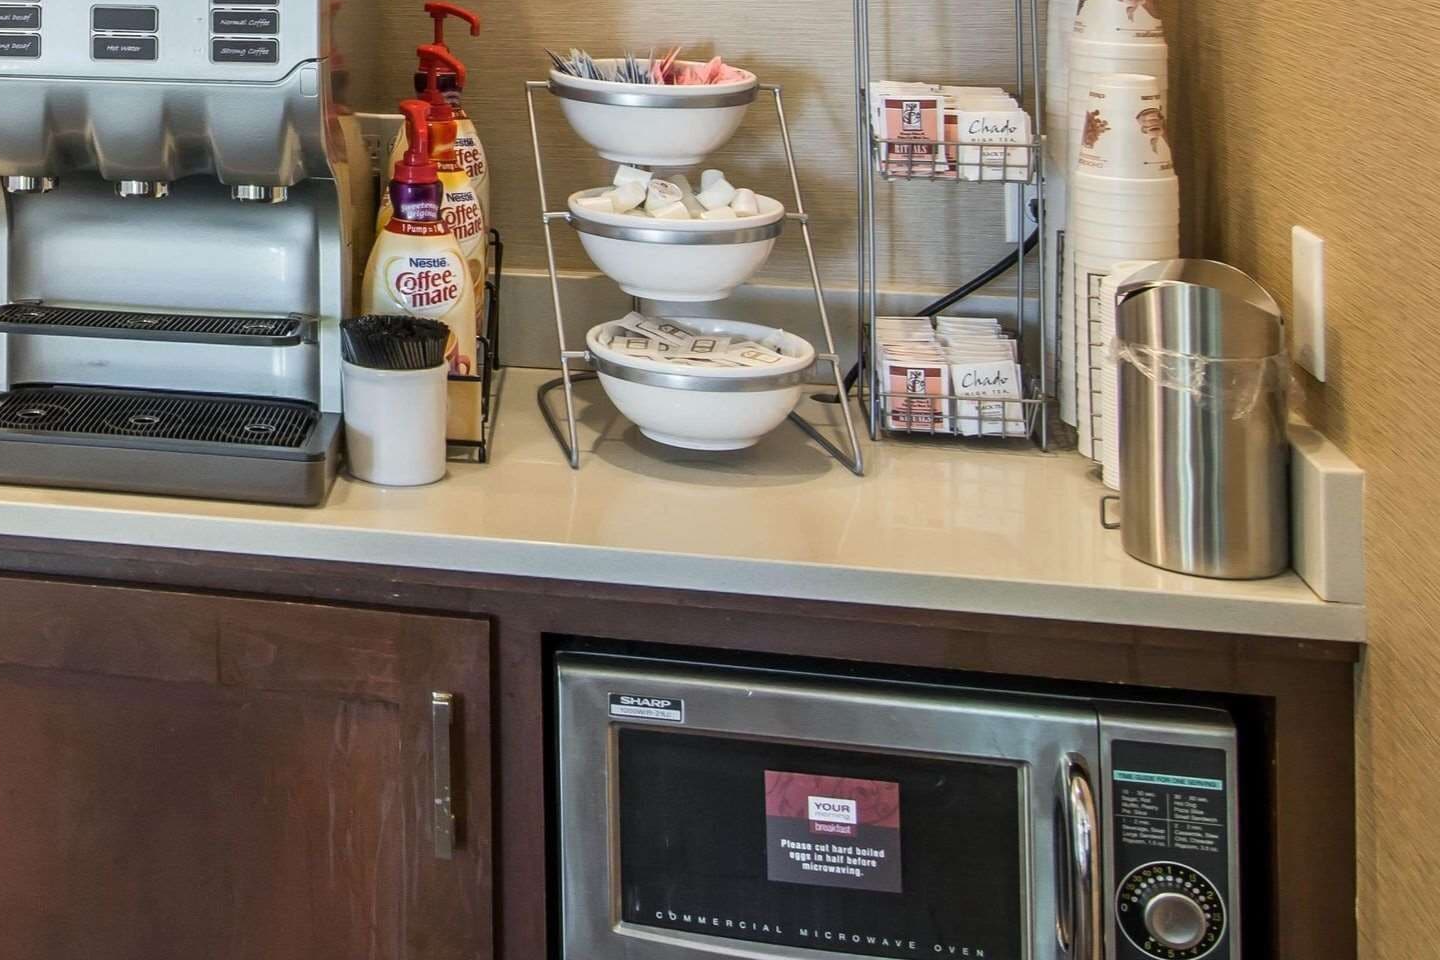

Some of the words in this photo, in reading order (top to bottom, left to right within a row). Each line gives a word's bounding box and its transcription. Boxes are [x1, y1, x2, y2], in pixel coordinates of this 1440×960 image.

[968, 117, 1017, 134] Chado
[406, 224, 427, 234] Pump
[411, 284, 457, 308] mate
[962, 370, 1009, 388] Chado
[620, 696, 672, 708] SHARP
[814, 802, 850, 813] YOUR
[814, 822, 852, 834] breakfast
[781, 839, 812, 851] Please
[815, 844, 829, 853] cut
[832, 845, 853, 855] hard
[856, 847, 885, 858] boiled
[789, 852, 811, 862] eggs
[814, 852, 824, 861] in
[825, 853, 844, 864] half
[846, 856, 877, 867] before
[802, 862, 864, 877] microwaving.
[656, 911, 783, 934] COMMERCIAL
[799, 928, 917, 949] MICROWAVE
[934, 944, 985, 958] OVEN
